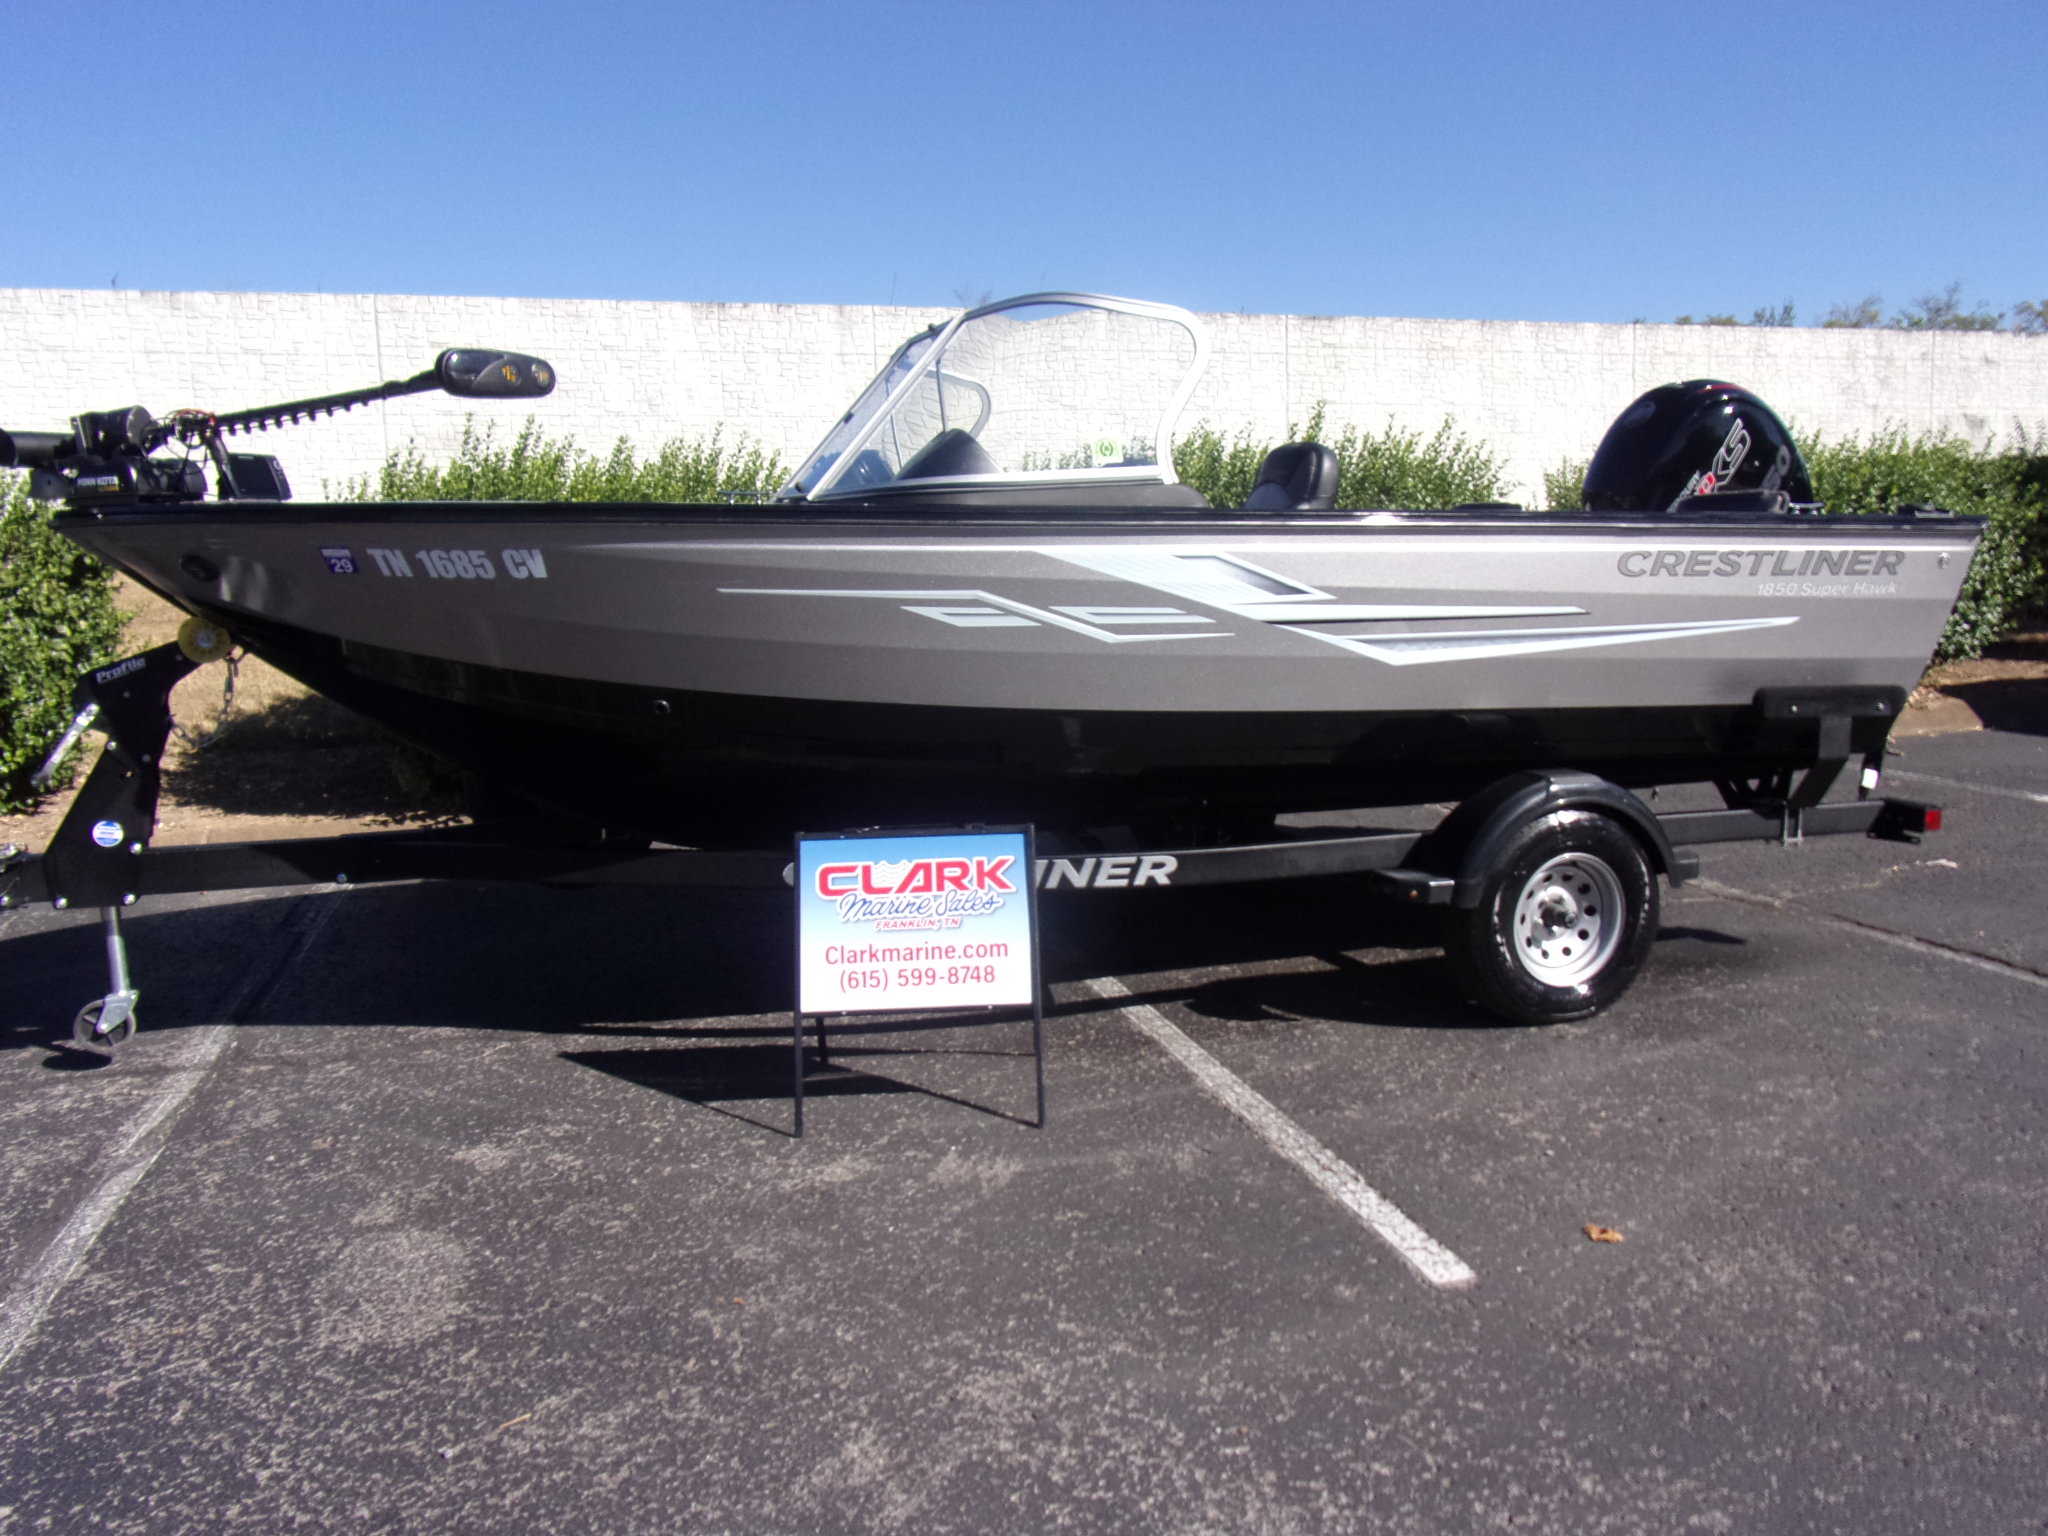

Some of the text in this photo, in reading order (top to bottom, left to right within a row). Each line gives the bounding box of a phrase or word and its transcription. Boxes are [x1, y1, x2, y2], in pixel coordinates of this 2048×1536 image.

[330, 558, 353, 573] 29
[366, 548, 413, 577] TN
[415, 550, 496, 579] 1685
[1617, 550, 1906, 577] CRESTLINER
[1757, 582, 1798, 596] 1850
[1800, 582, 1850, 597] Super
[96, 657, 147, 684] Profile
[818, 858, 1015, 897] CLARK
[840, 889, 1001, 919] Marine Sales
[944, 917, 960, 926] TN
[825, 941, 1009, 965] Clarkmarine.com
[840, 965, 996, 993] (615) 599-8748
